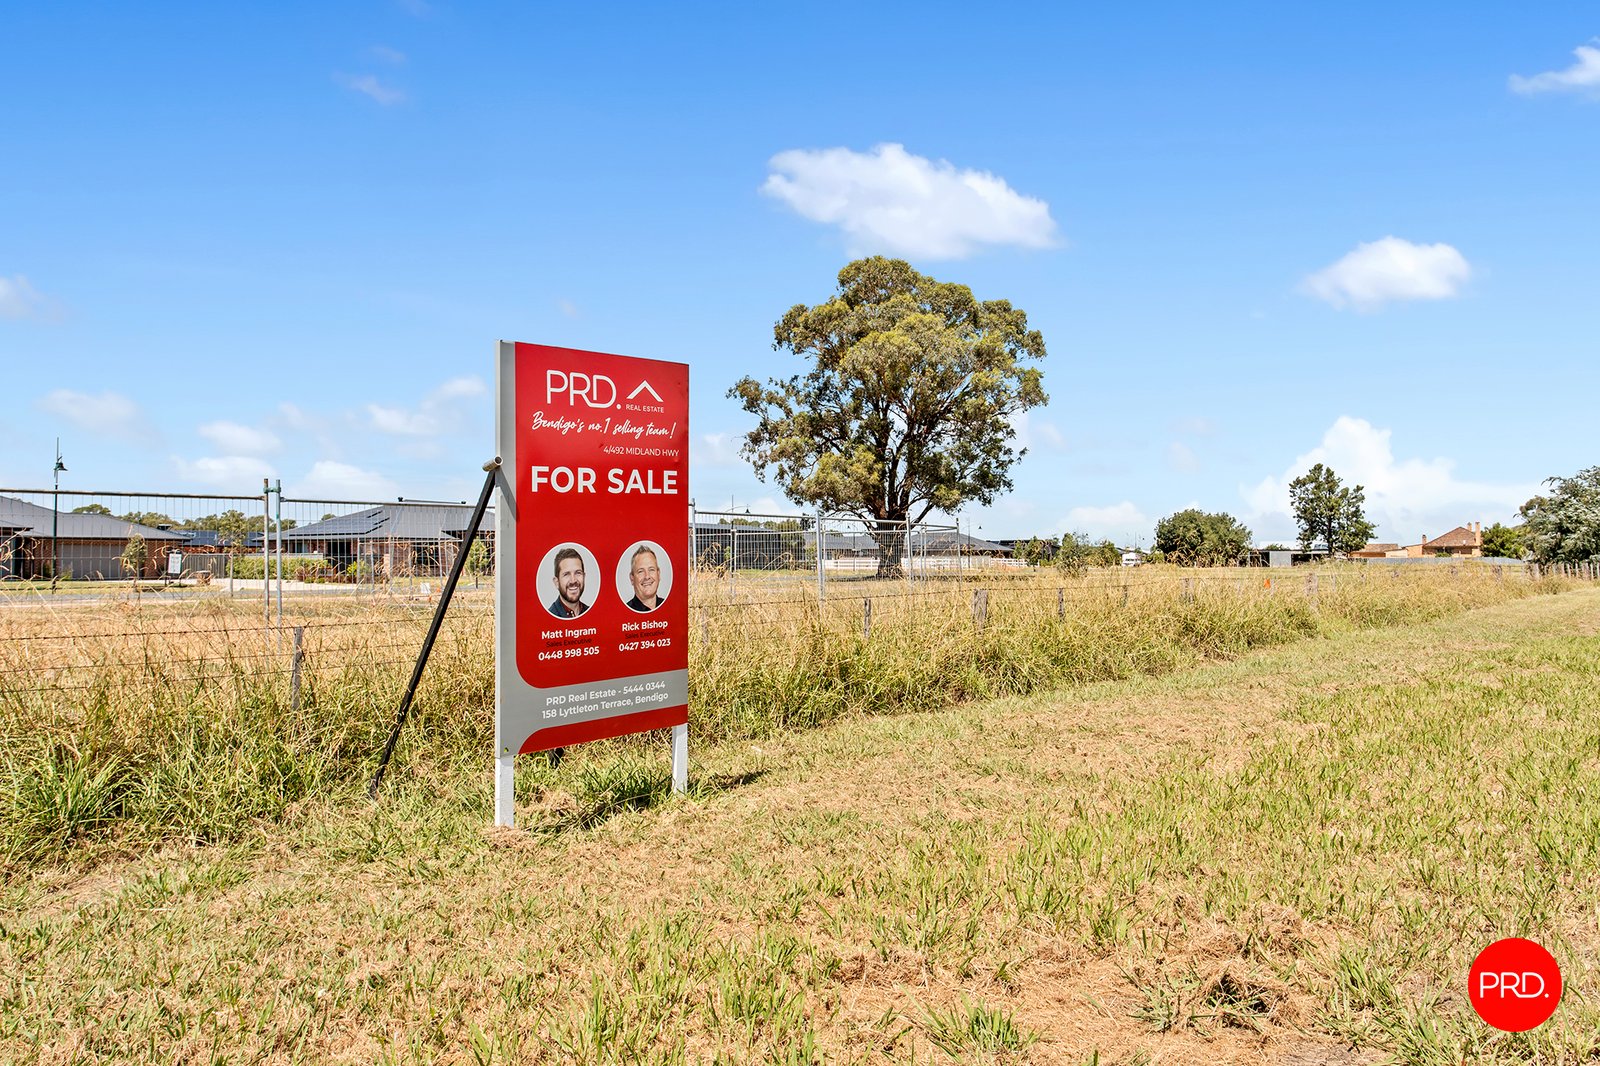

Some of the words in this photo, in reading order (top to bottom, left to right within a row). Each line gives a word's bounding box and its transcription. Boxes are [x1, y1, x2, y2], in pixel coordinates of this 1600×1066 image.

[547, 370, 621, 408] PRD.
[532, 411, 584, 435] Bendigo's
[588, 418, 610, 434] no.1
[613, 421, 644, 439] selling
[604, 445, 624, 455] 4/492
[626, 448, 661, 456] MIDLAND
[662, 449, 679, 457] HWY
[532, 466, 596, 493] FOR
[608, 468, 677, 494] SALE
[622, 622, 639, 631] Rick
[642, 620, 668, 630] Bishop
[541, 630, 562, 639] Matt
[565, 627, 596, 639] Ingram
[640, 630, 665, 638] Executive
[564, 638, 592, 646] Executive
[619, 643, 638, 651] 0427
[641, 641, 655, 649] 394
[657, 639, 671, 647] 023
[538, 651, 562, 661] 0448
[565, 649, 582, 658] 998
[584, 647, 599, 655] 505
[546, 696, 565, 706] PRD
[569, 692, 587, 702] Real
[590, 689, 616, 699] Estate
[623, 684, 644, 695] 5444
[646, 681, 665, 691] 0344
[542, 710, 556, 719] 158
[559, 704, 598, 718] Lyttleton
[601, 698, 633, 709] Terrace,
[636, 692, 668, 704] Bendigo
